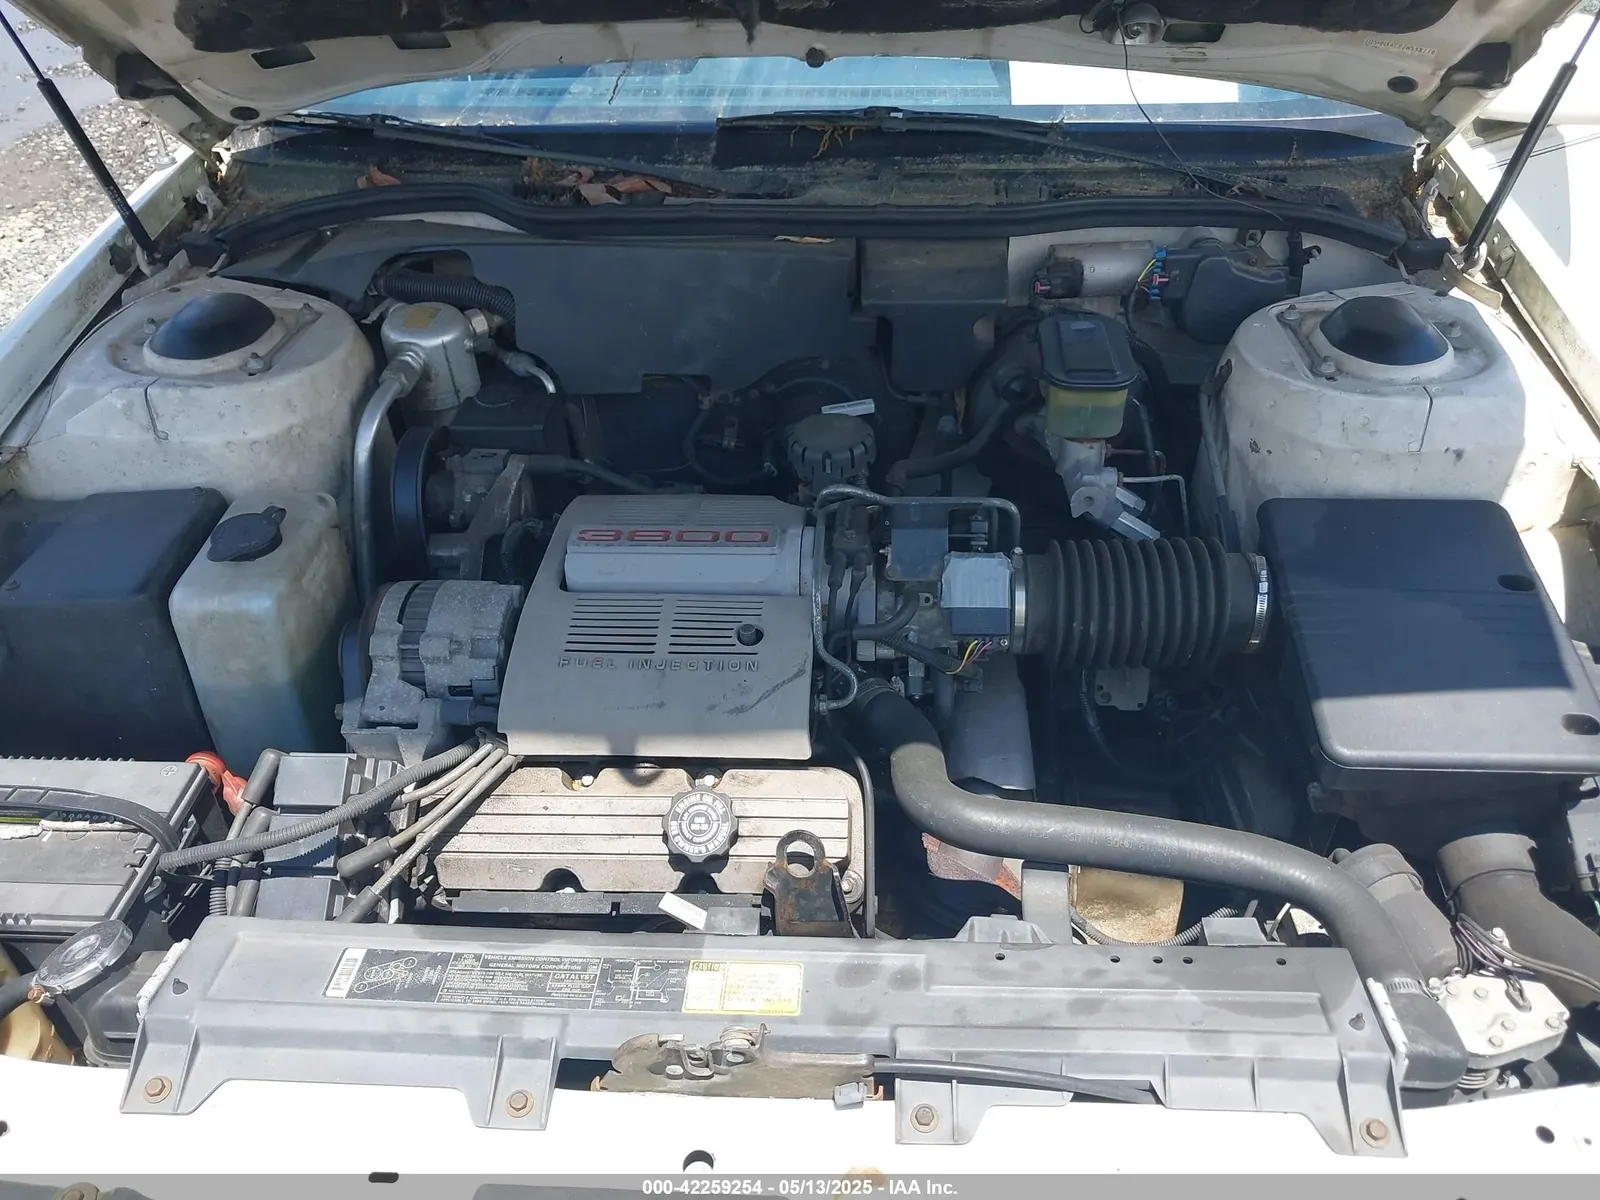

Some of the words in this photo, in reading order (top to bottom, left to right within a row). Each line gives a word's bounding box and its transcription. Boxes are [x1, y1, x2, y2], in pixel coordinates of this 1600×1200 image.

[577, 529, 769, 543] 3800
[558, 657, 618, 669] FUEL
[628, 658, 760, 673] INJECTION
[675, 794, 700, 813] ENGINE
[702, 794, 714, 804] OIL
[713, 800, 726, 815] FILL
